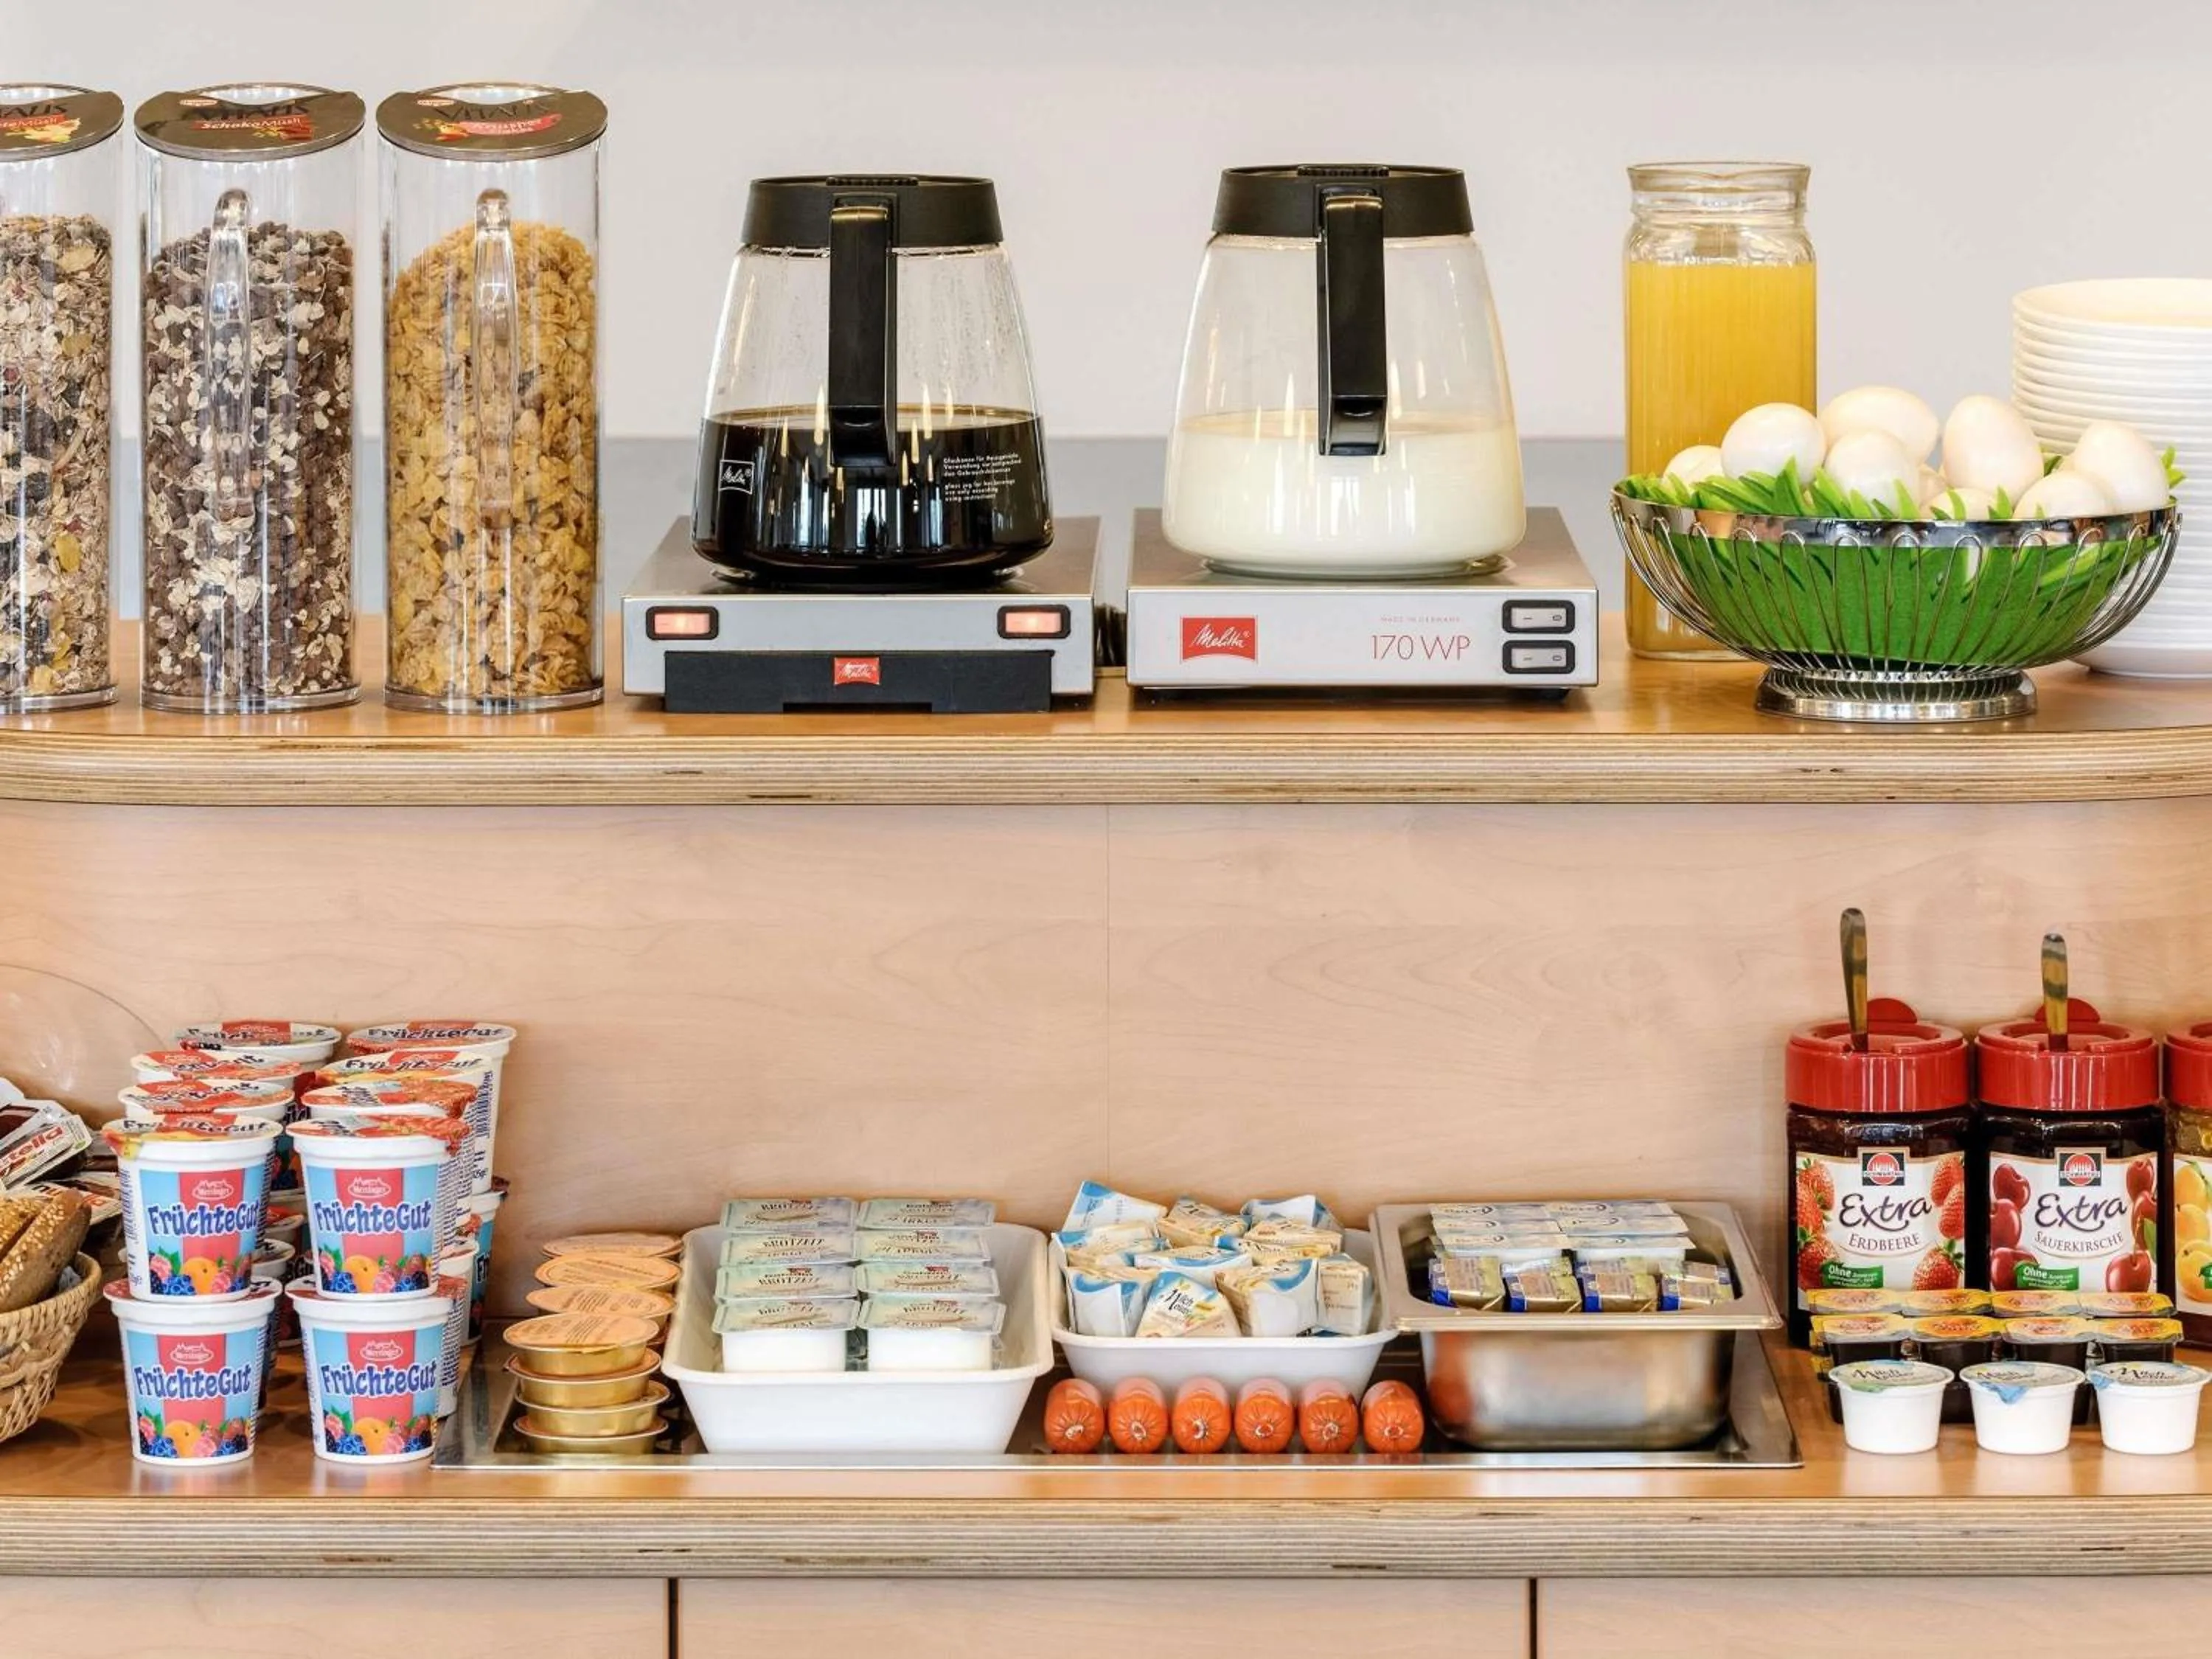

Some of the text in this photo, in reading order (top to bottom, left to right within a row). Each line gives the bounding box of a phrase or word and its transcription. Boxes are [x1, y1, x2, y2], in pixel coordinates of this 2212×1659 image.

[1371, 635, 1472, 661] 170 WP
[122, 1119, 269, 1133] FrühteGut
[147, 1202, 259, 1236] FrüchteGut
[314, 1200, 431, 1234] FrüchteGut
[1839, 1193, 1932, 1232] Extra
[2035, 1193, 2127, 1232] Extra
[1848, 1233, 1921, 1251] ERDBEERE
[2034, 1231, 2124, 1252] SAUERKIRSCHE
[1829, 1264, 1851, 1278] Ohne
[2023, 1266, 2048, 1279] Ohne
[133, 1364, 252, 1399] FrüchteGut
[321, 1360, 437, 1396] FrüchteGut
